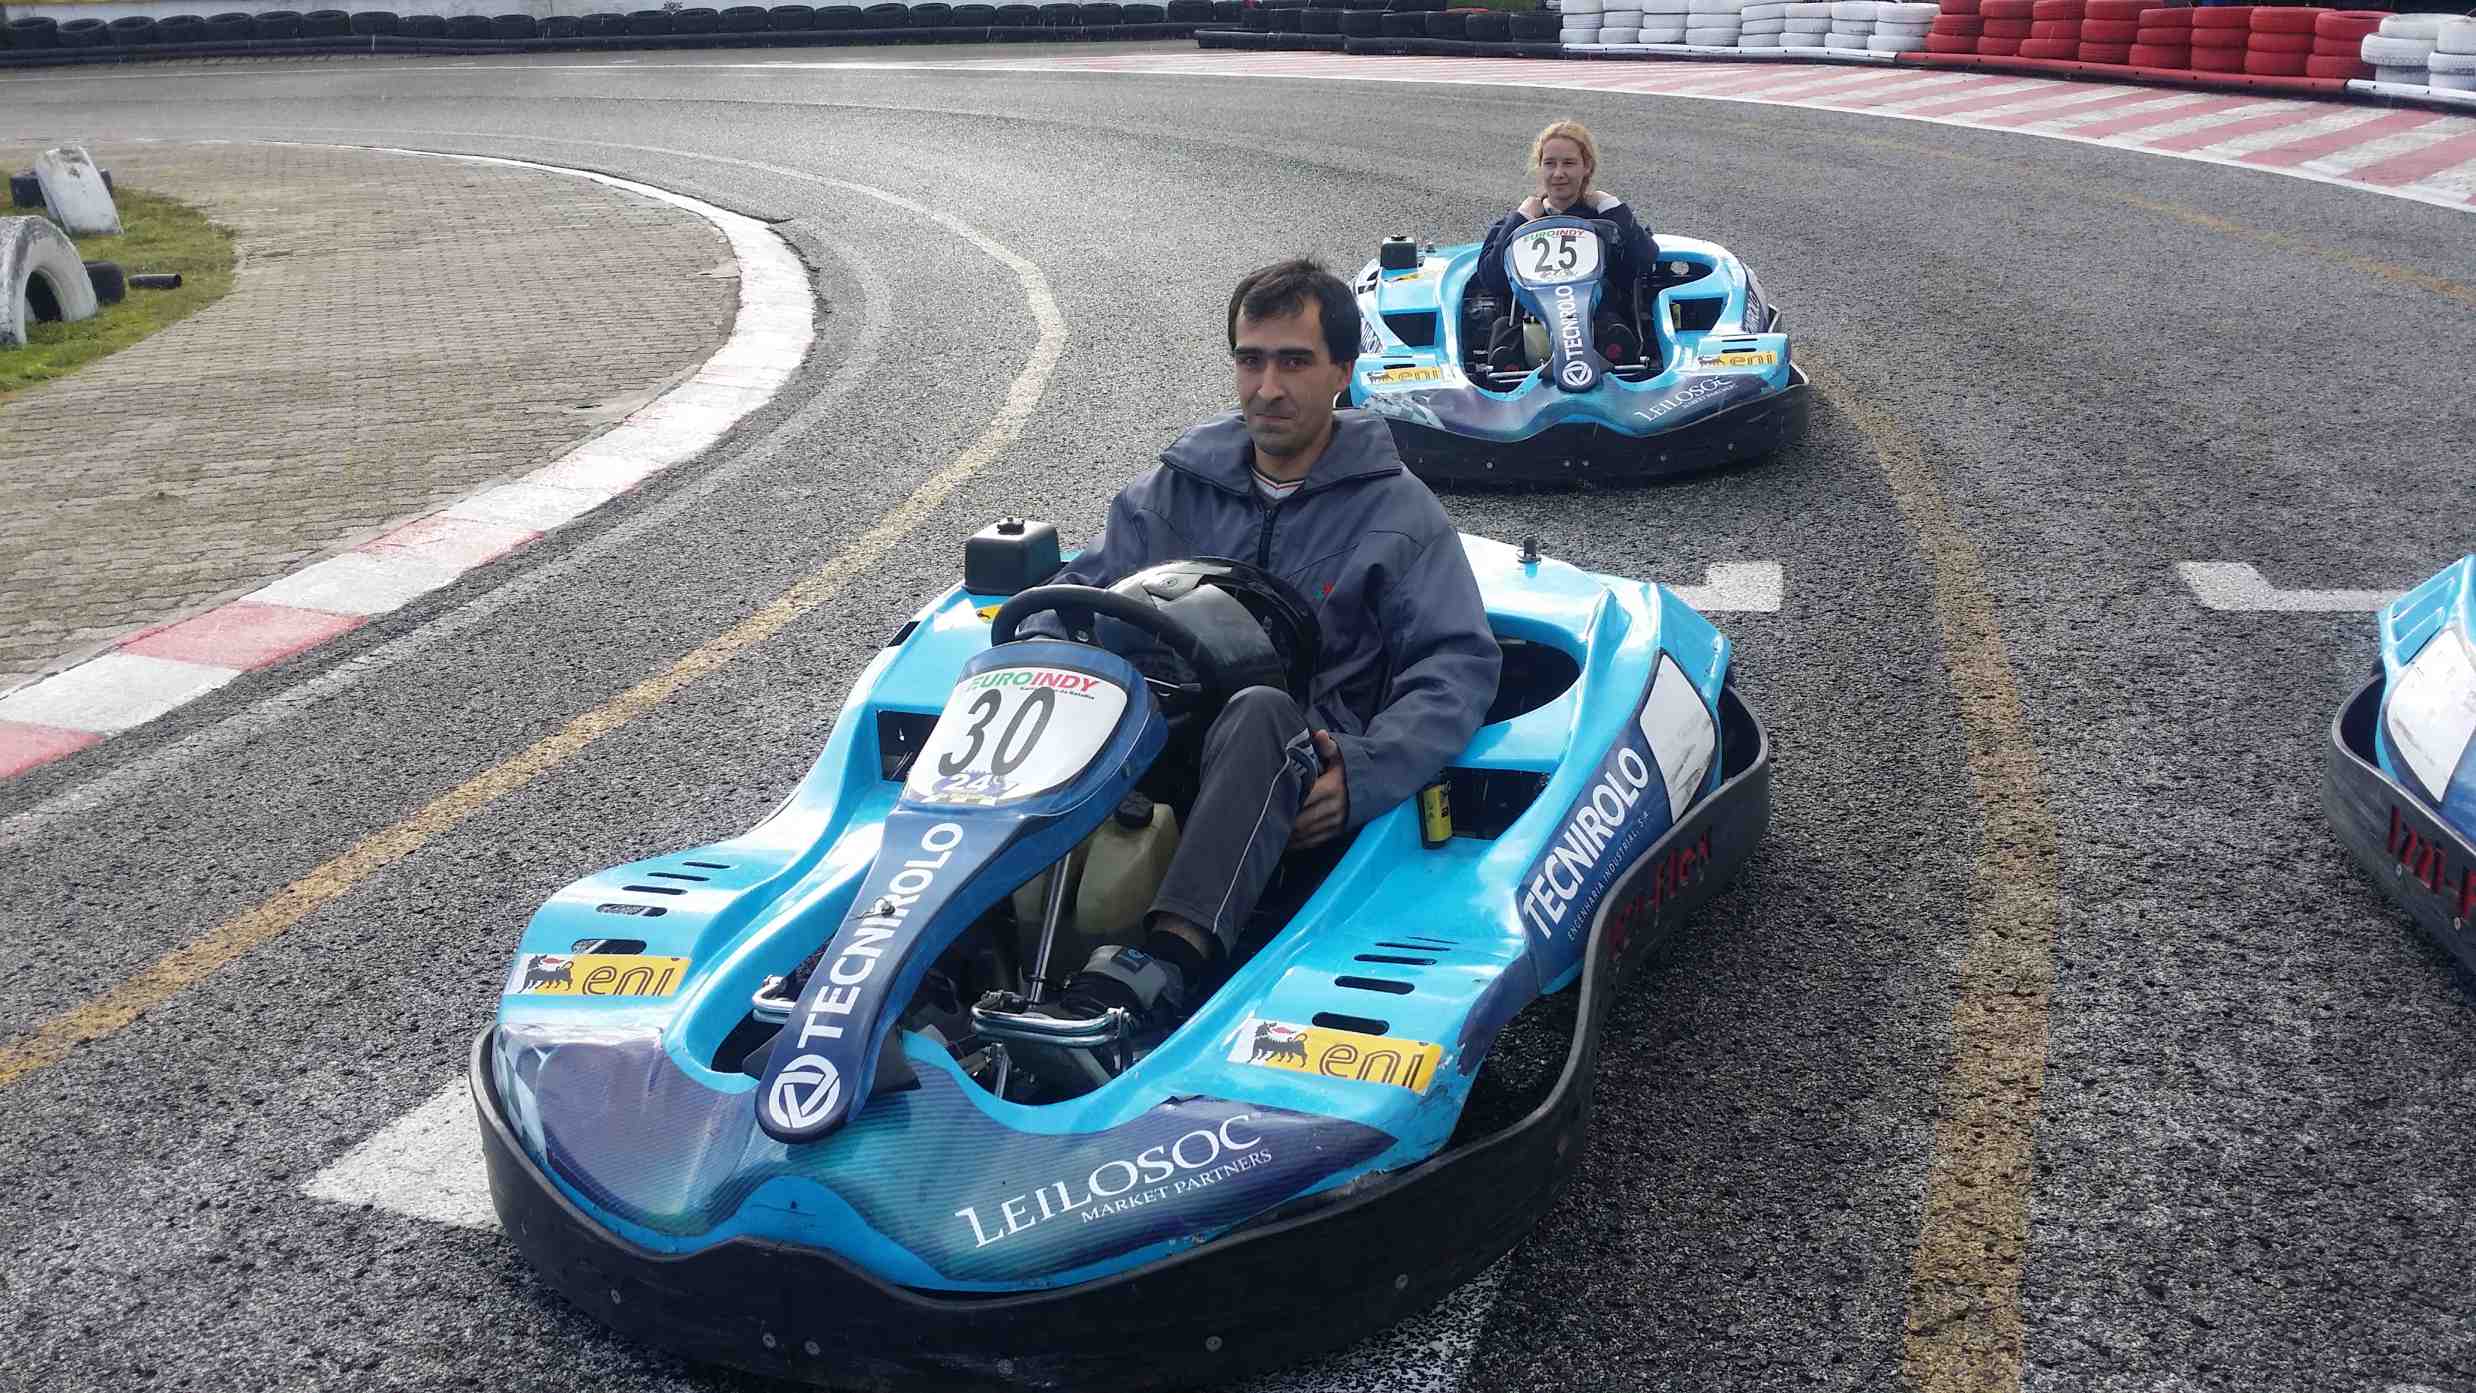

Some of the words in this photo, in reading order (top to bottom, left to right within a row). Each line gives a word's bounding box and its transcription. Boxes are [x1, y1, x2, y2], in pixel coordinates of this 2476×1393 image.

[1532, 235, 1577, 272] 25
[967, 669, 1100, 692] EUROINDY
[938, 686, 1056, 777] 30
[1523, 747, 1649, 939] TECNIROLO
[797, 822, 964, 1049] TECNIROLO
[581, 957, 681, 997] eni
[1318, 1041, 1430, 1089] eni
[954, 1114, 1262, 1249] LEILOSOC
[1080, 1185, 1170, 1225] MARKET
[1175, 1148, 1273, 1195] PARTNERS
